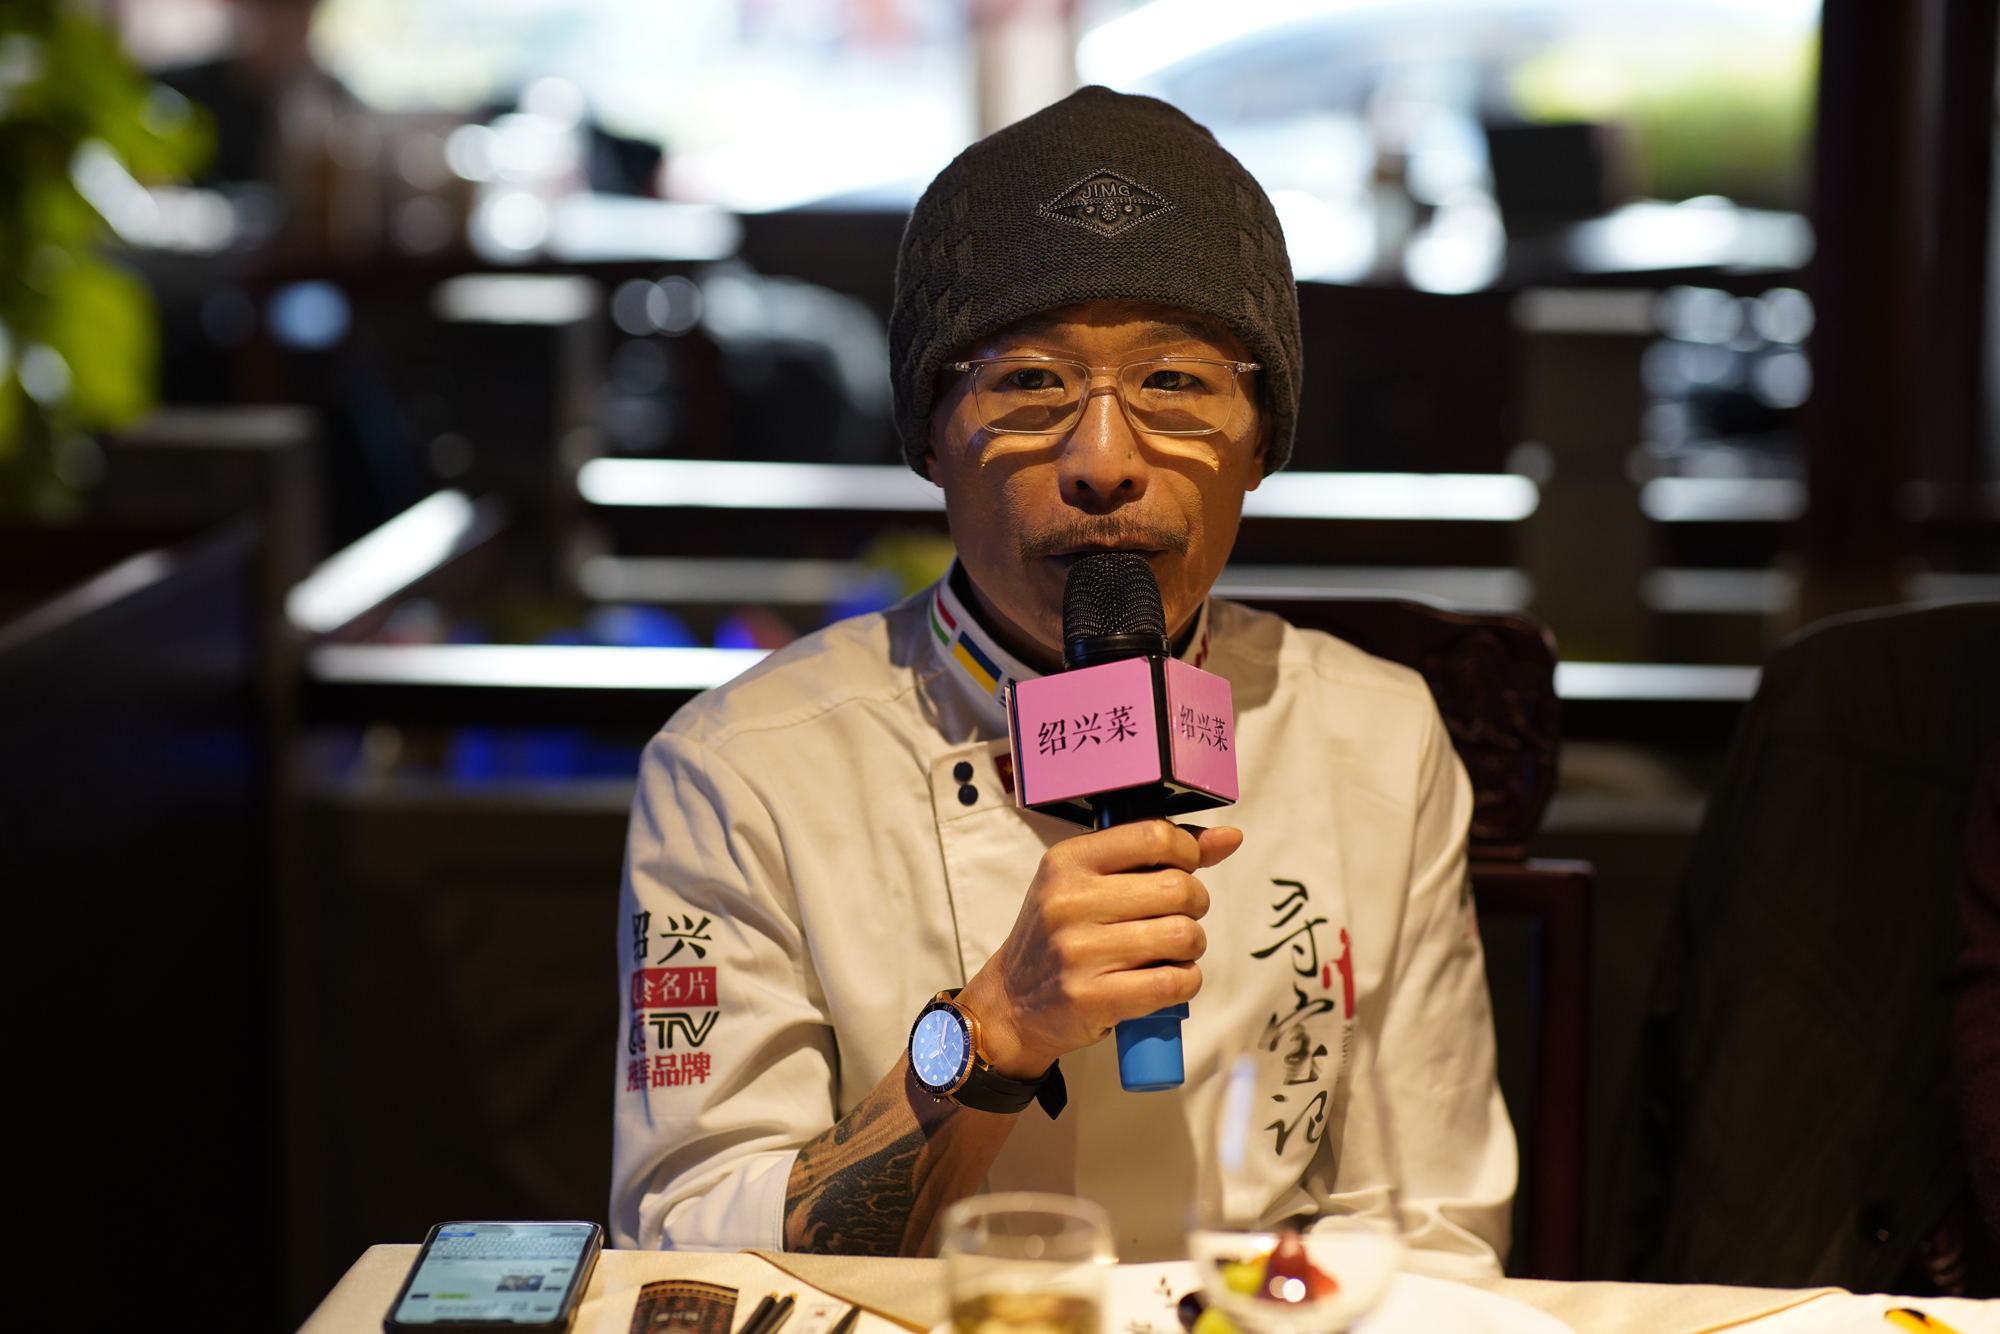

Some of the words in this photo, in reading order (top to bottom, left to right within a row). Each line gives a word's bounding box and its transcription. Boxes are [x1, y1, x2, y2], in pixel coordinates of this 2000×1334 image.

[1082, 182, 1130, 199] JIMG
[1038, 705, 1138, 756] 绍兴菜
[1179, 704, 1228, 752] 绍兴菜
[943, 1003, 954, 1014] 40
[1250, 877, 1335, 1157] 寻宝记
